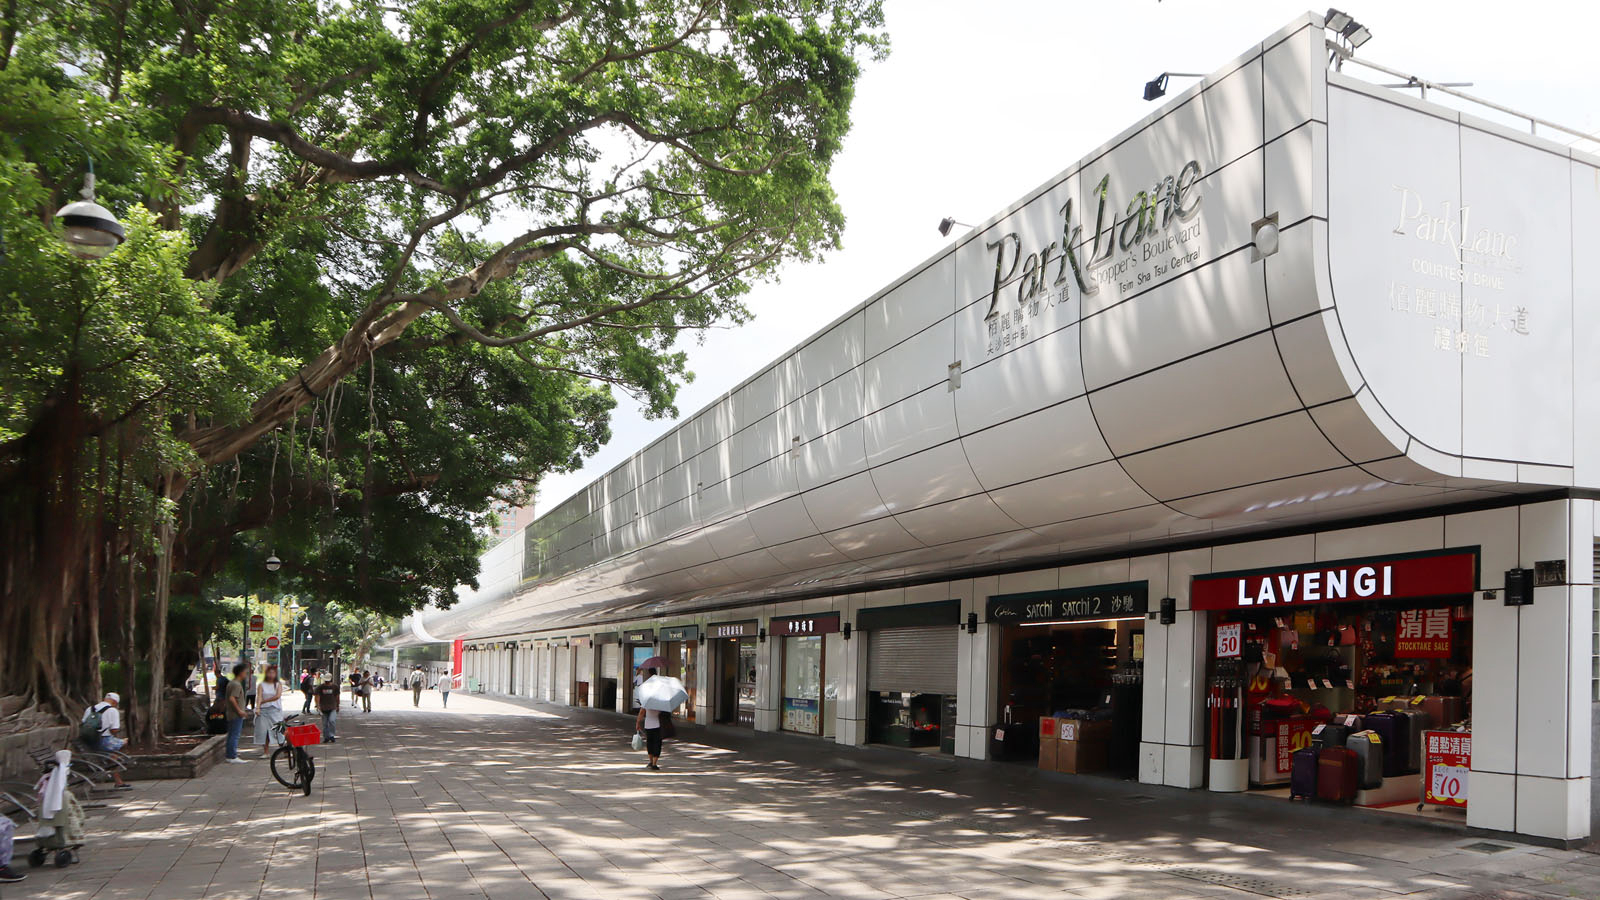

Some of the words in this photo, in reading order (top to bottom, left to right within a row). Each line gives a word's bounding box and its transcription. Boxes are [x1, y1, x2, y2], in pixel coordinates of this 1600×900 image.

[1392, 184, 1466, 264] Park
[1457, 204, 1518, 260] Lane
[984, 197, 1099, 322] Park
[1086, 160, 1203, 272] Lane
[1089, 250, 1137, 288] Shopper's
[1143, 216, 1202, 263] Boulevard
[1119, 279, 1134, 295] Tsim
[1137, 270, 1151, 286] Sha
[1154, 263, 1168, 279] Tsui
[1170, 246, 1201, 271] Central
[1412, 258, 1470, 283] COURTESY
[1473, 273, 1505, 290] DRIVE
[1237, 565, 1393, 606] LAVENGI
[1092, 596, 1102, 614] 2
[1399, 608, 1450, 639] 清貨
[1218, 636, 1237, 654] $50
[1398, 641, 1432, 651] STOCKTAKE
[1433, 641, 1449, 651] SALE
[1429, 735, 1471, 756] 盤點清貨
[1440, 775, 1461, 797] 10
